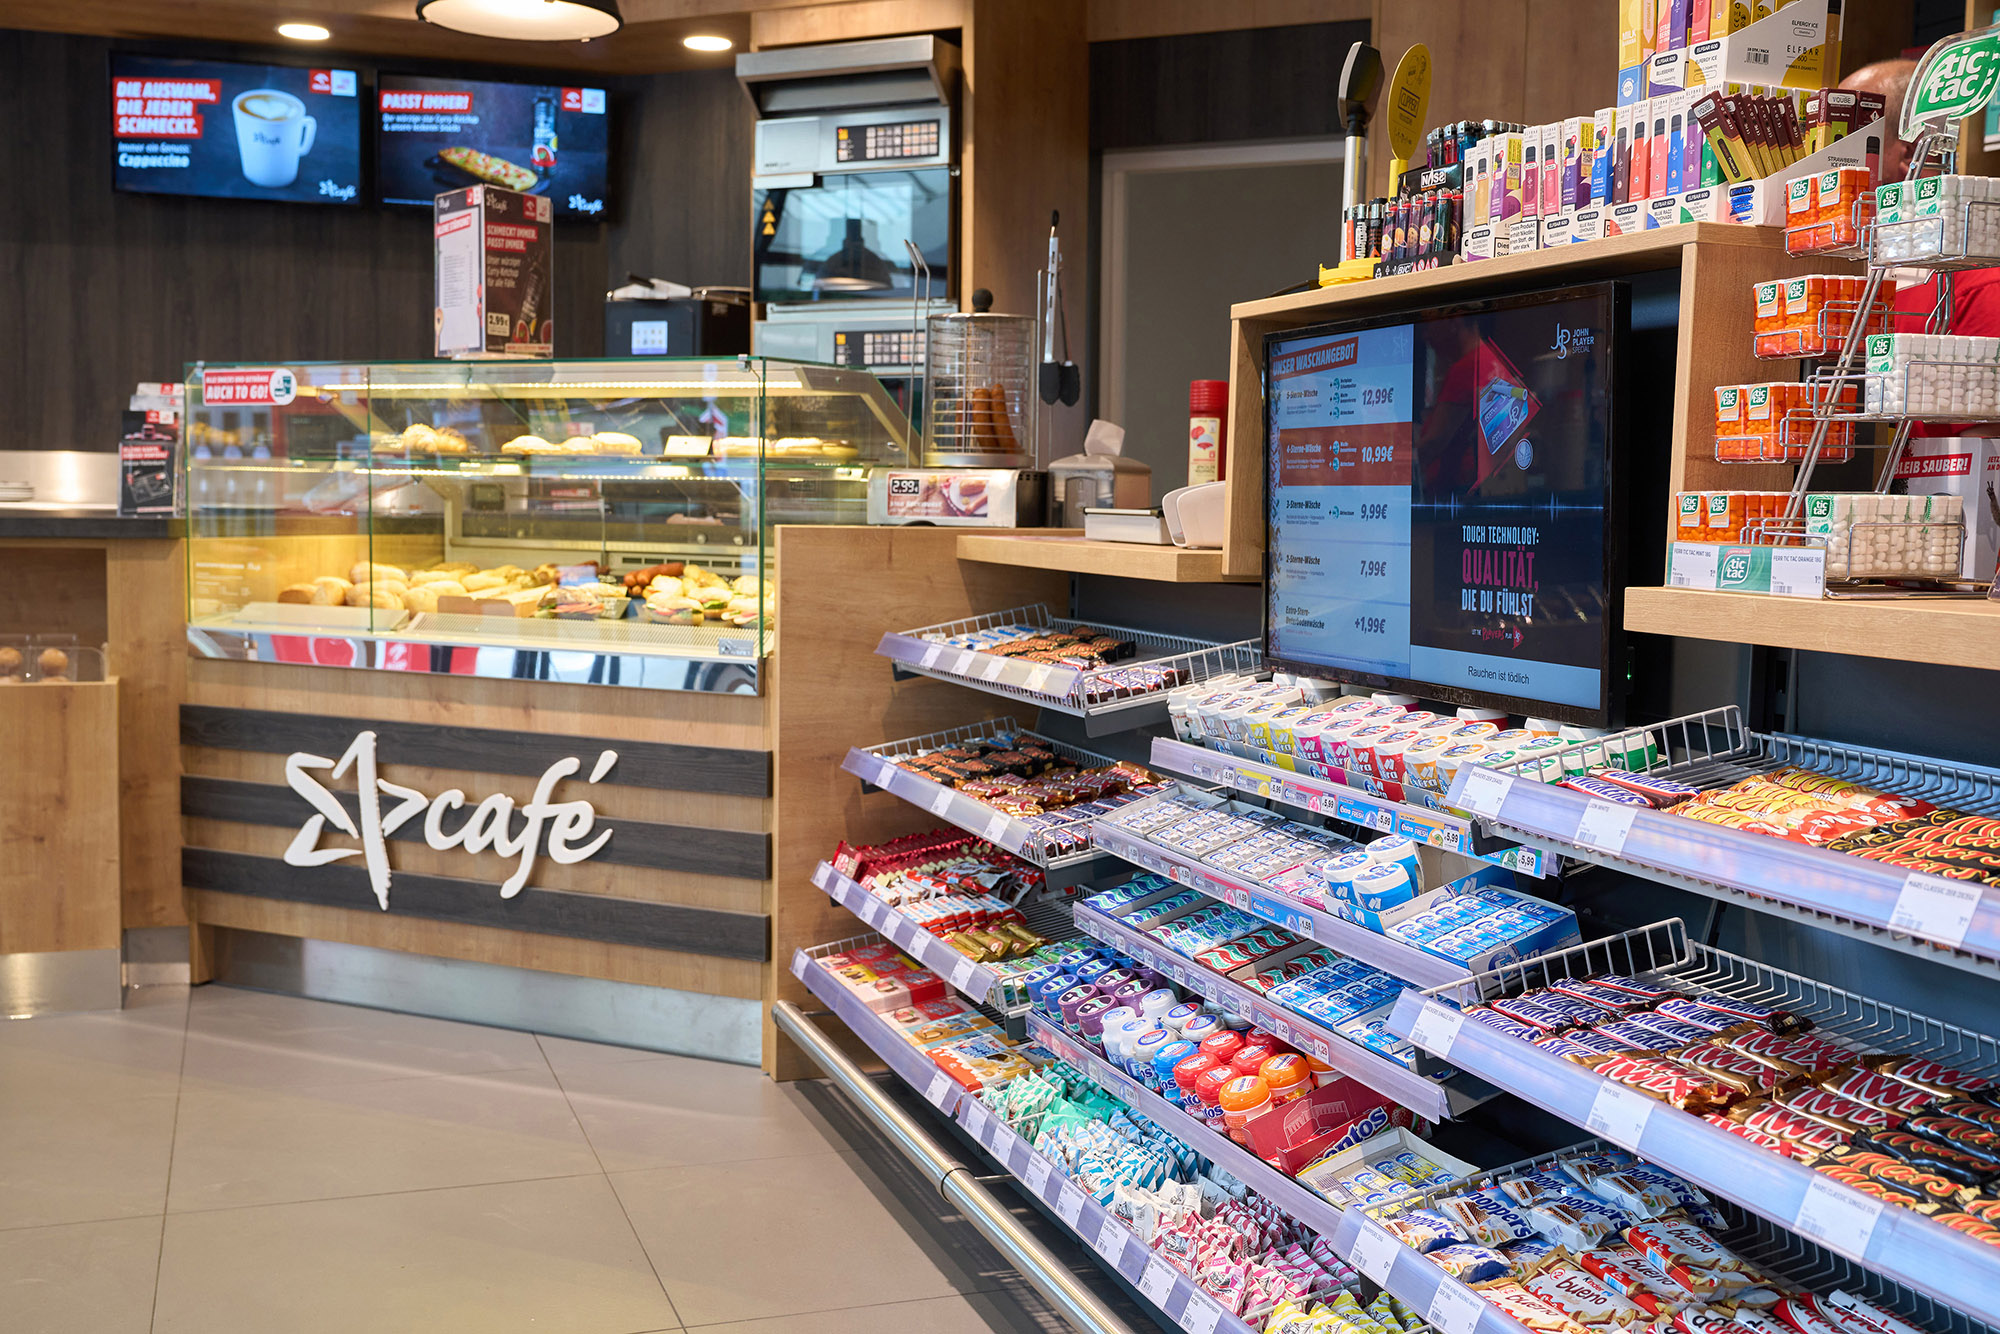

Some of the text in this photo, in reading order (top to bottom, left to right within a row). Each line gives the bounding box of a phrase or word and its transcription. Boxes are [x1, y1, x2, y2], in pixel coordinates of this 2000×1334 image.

[1622, 30, 1636, 40] MILK
[1787, 45, 1819, 56] ELFBAR
[1945, 47, 1986, 80] tic
[116, 81, 142, 98] DIE
[1928, 73, 1978, 104] tac
[382, 92, 470, 111] PASST IMMER!
[117, 99, 194, 117] DIE JEDEM
[118, 153, 190, 169] Cappuccino
[1828, 156, 1859, 164] STRAWBERRY
[1825, 173, 1837, 184] tic
[1796, 180, 1808, 191] tic
[1823, 181, 1836, 190] tac
[1923, 181, 1936, 191] tic
[1794, 188, 1807, 198] tac
[1885, 189, 1898, 200] tic
[1921, 188, 1935, 198] tac
[1882, 197, 1897, 207] tac
[487, 224, 537, 240] SCHMECKT IMMER.
[487, 237, 526, 251] PASST IMMER.
[1397, 265, 1411, 275] BIC
[1763, 284, 1776, 295] tic
[1792, 280, 1805, 291] tic
[1760, 292, 1775, 302] tac
[1789, 288, 1803, 298] tac
[1572, 328, 1590, 338] JOHN
[1572, 336, 1595, 347] PLAYER
[1876, 339, 1889, 349] tic
[1873, 346, 1888, 355] tac
[1296, 343, 1356, 372] WASCHANGEBOT
[206, 385, 269, 400] AUCH TO GO!
[1362, 387, 1394, 406] 12,99€
[1724, 391, 1737, 400] tic
[1755, 388, 1767, 397] tic
[1721, 397, 1736, 406] tac
[1752, 395, 1766, 404] tac
[1362, 446, 1393, 465] 10,99€
[1922, 457, 1969, 474] SAUBER!
[1817, 499, 1829, 509] tic
[1361, 504, 1387, 521] 9,99€
[1813, 507, 1828, 516] tac
[1462, 525, 1540, 545] TOUCH TECHNOLOGY:
[1360, 560, 1386, 577] 7,99€
[1462, 546, 1539, 592] QUALITÄT,
[1731, 558, 1747, 570] tic
[1726, 567, 1745, 579] tac
[1461, 588, 1534, 617] DIE DU FÜHLST
[1354, 616, 1386, 634] +1,99€
[1468, 665, 1530, 685] Rauchen ist tödlich
[1787, 773, 1848, 795] LION
[1351, 809, 1364, 819] FRESH
[424, 750, 619, 899] café
[1415, 828, 1428, 837] FRESH
[1681, 1041, 1790, 1090] TWIX
[1594, 1053, 1696, 1103] TWIX
[1745, 1103, 1850, 1151] TWIX
[1835, 1151, 1965, 1197] Mars
[1670, 1225, 1715, 1254] bueno
[1622, 1257, 1676, 1285] bueno
[1555, 1276, 1607, 1305] bueno
